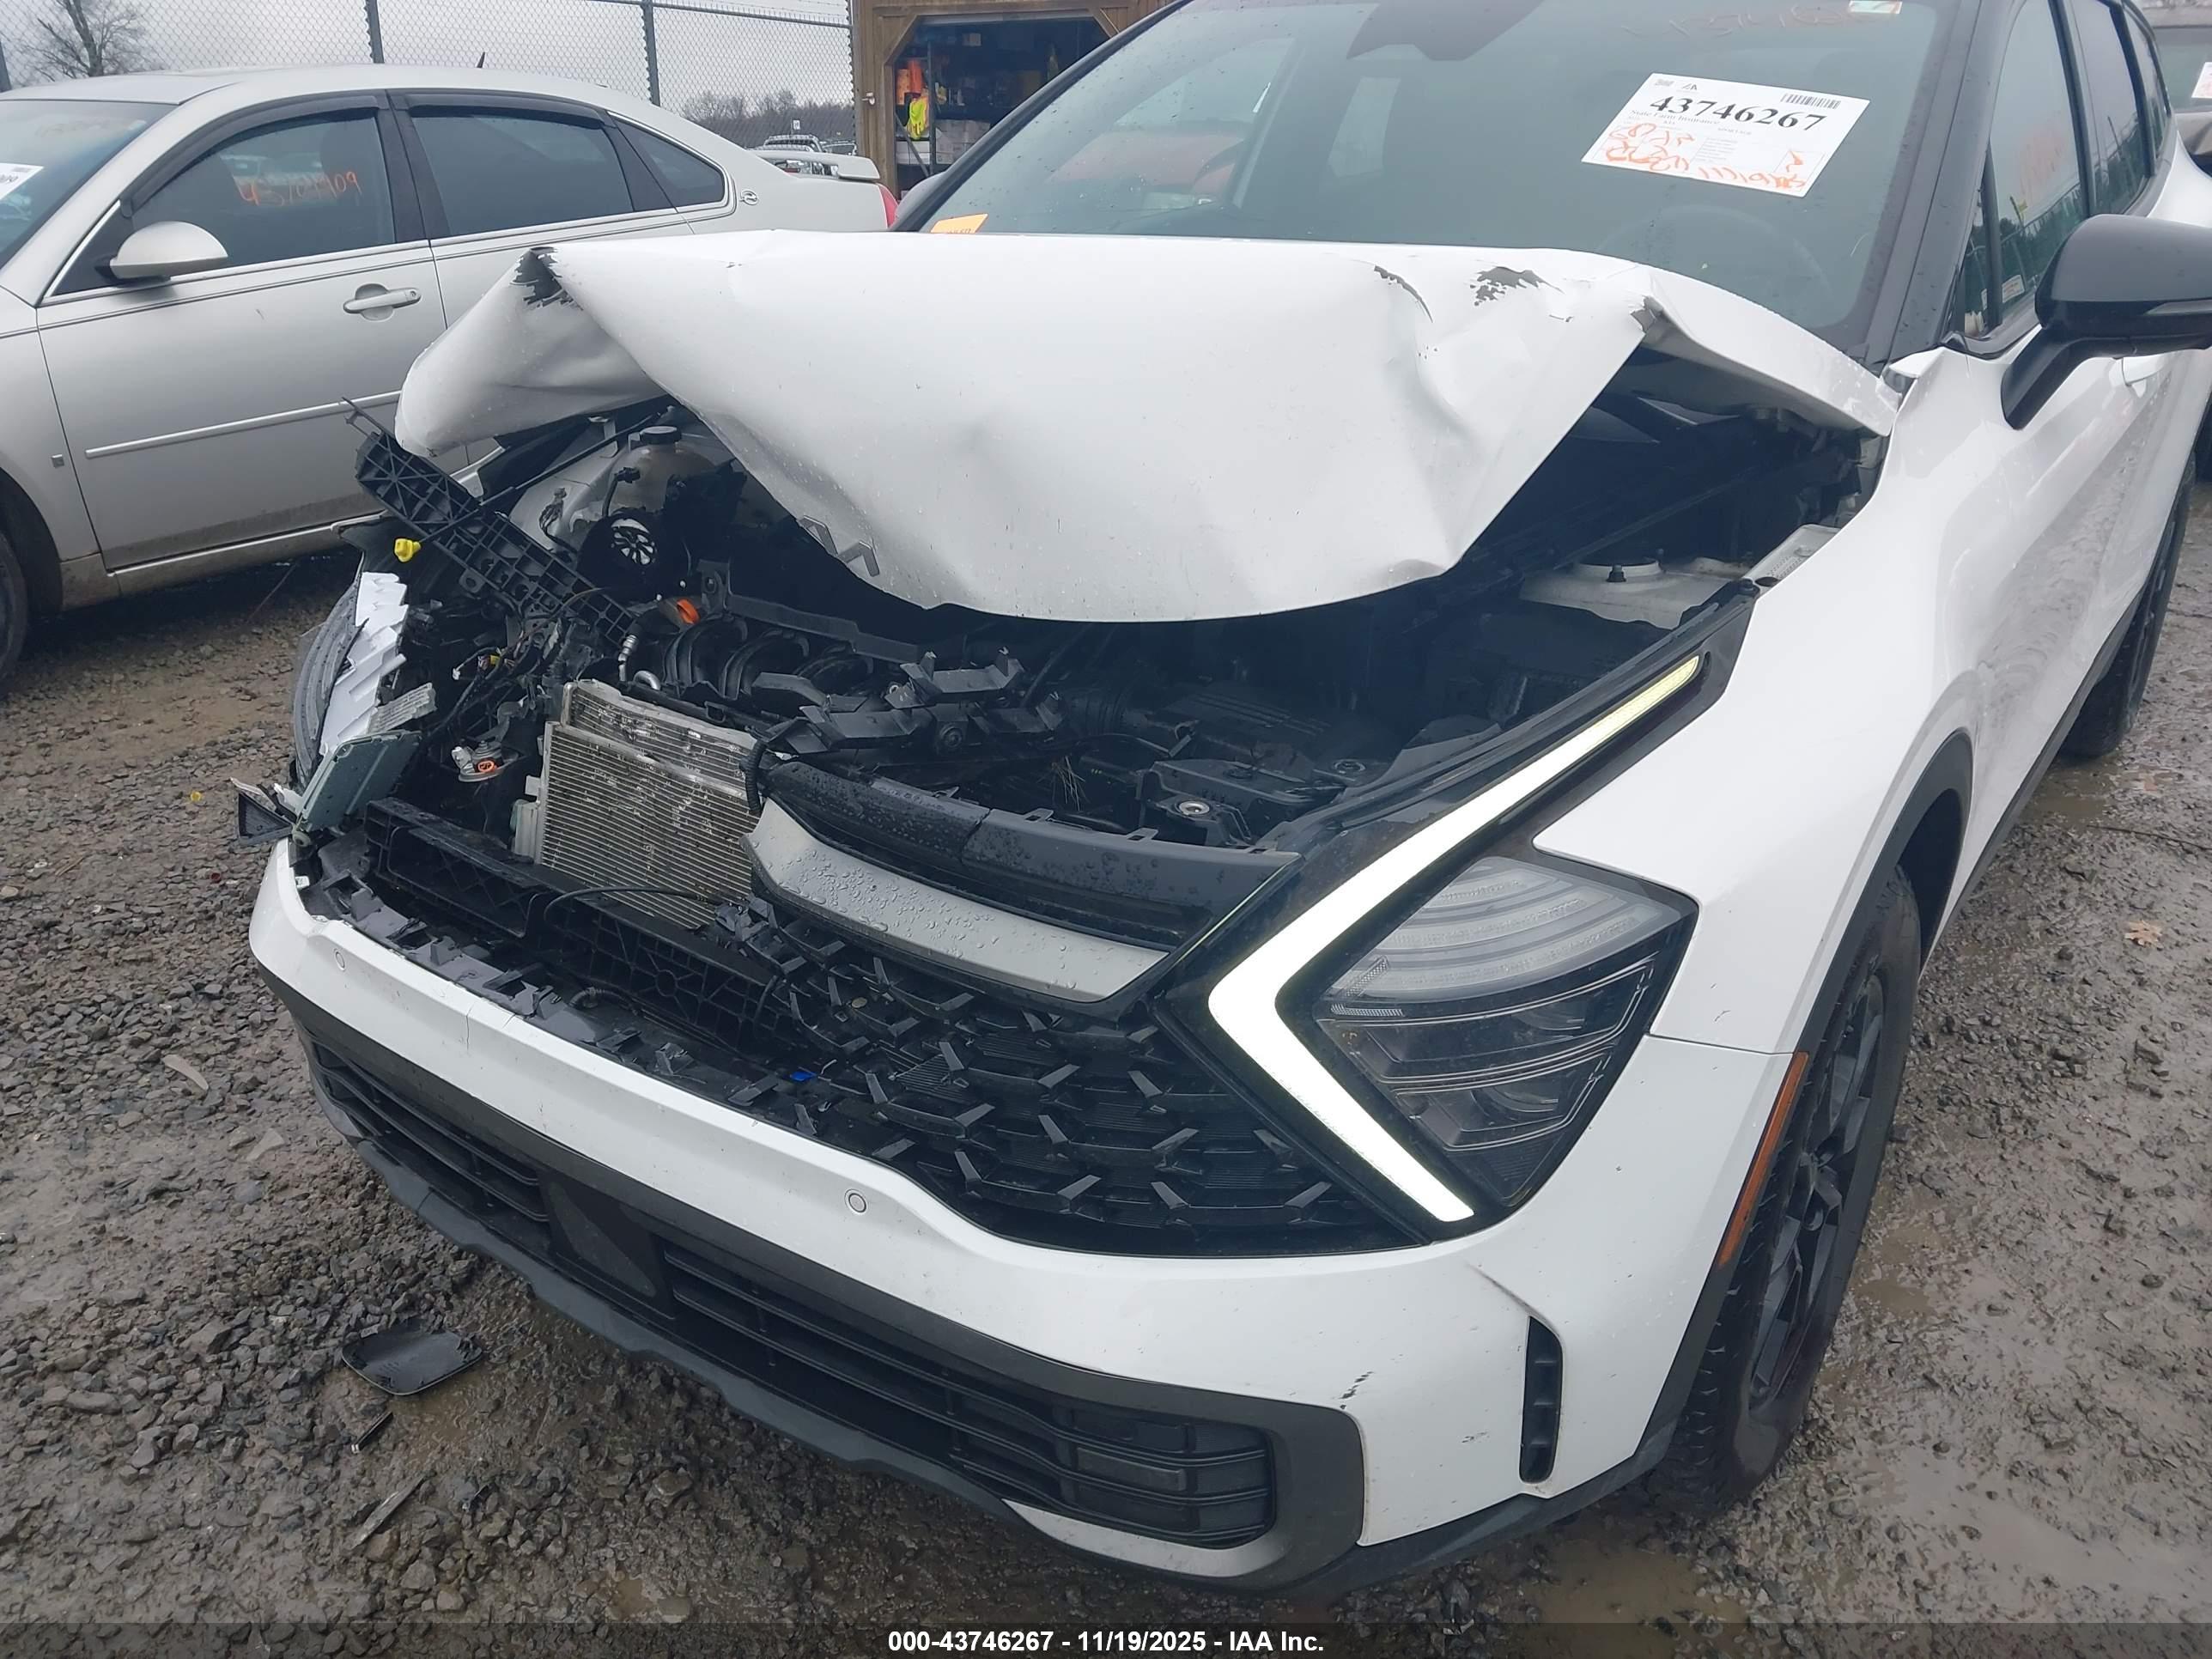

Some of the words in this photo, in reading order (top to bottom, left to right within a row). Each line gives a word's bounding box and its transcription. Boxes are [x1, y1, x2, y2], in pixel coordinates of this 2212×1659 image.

[1631, 109, 1654, 118] State
[1654, 112, 1677, 120] Farm
[1678, 114, 1721, 125] Insurance
[1650, 95, 1826, 132] 43746267
